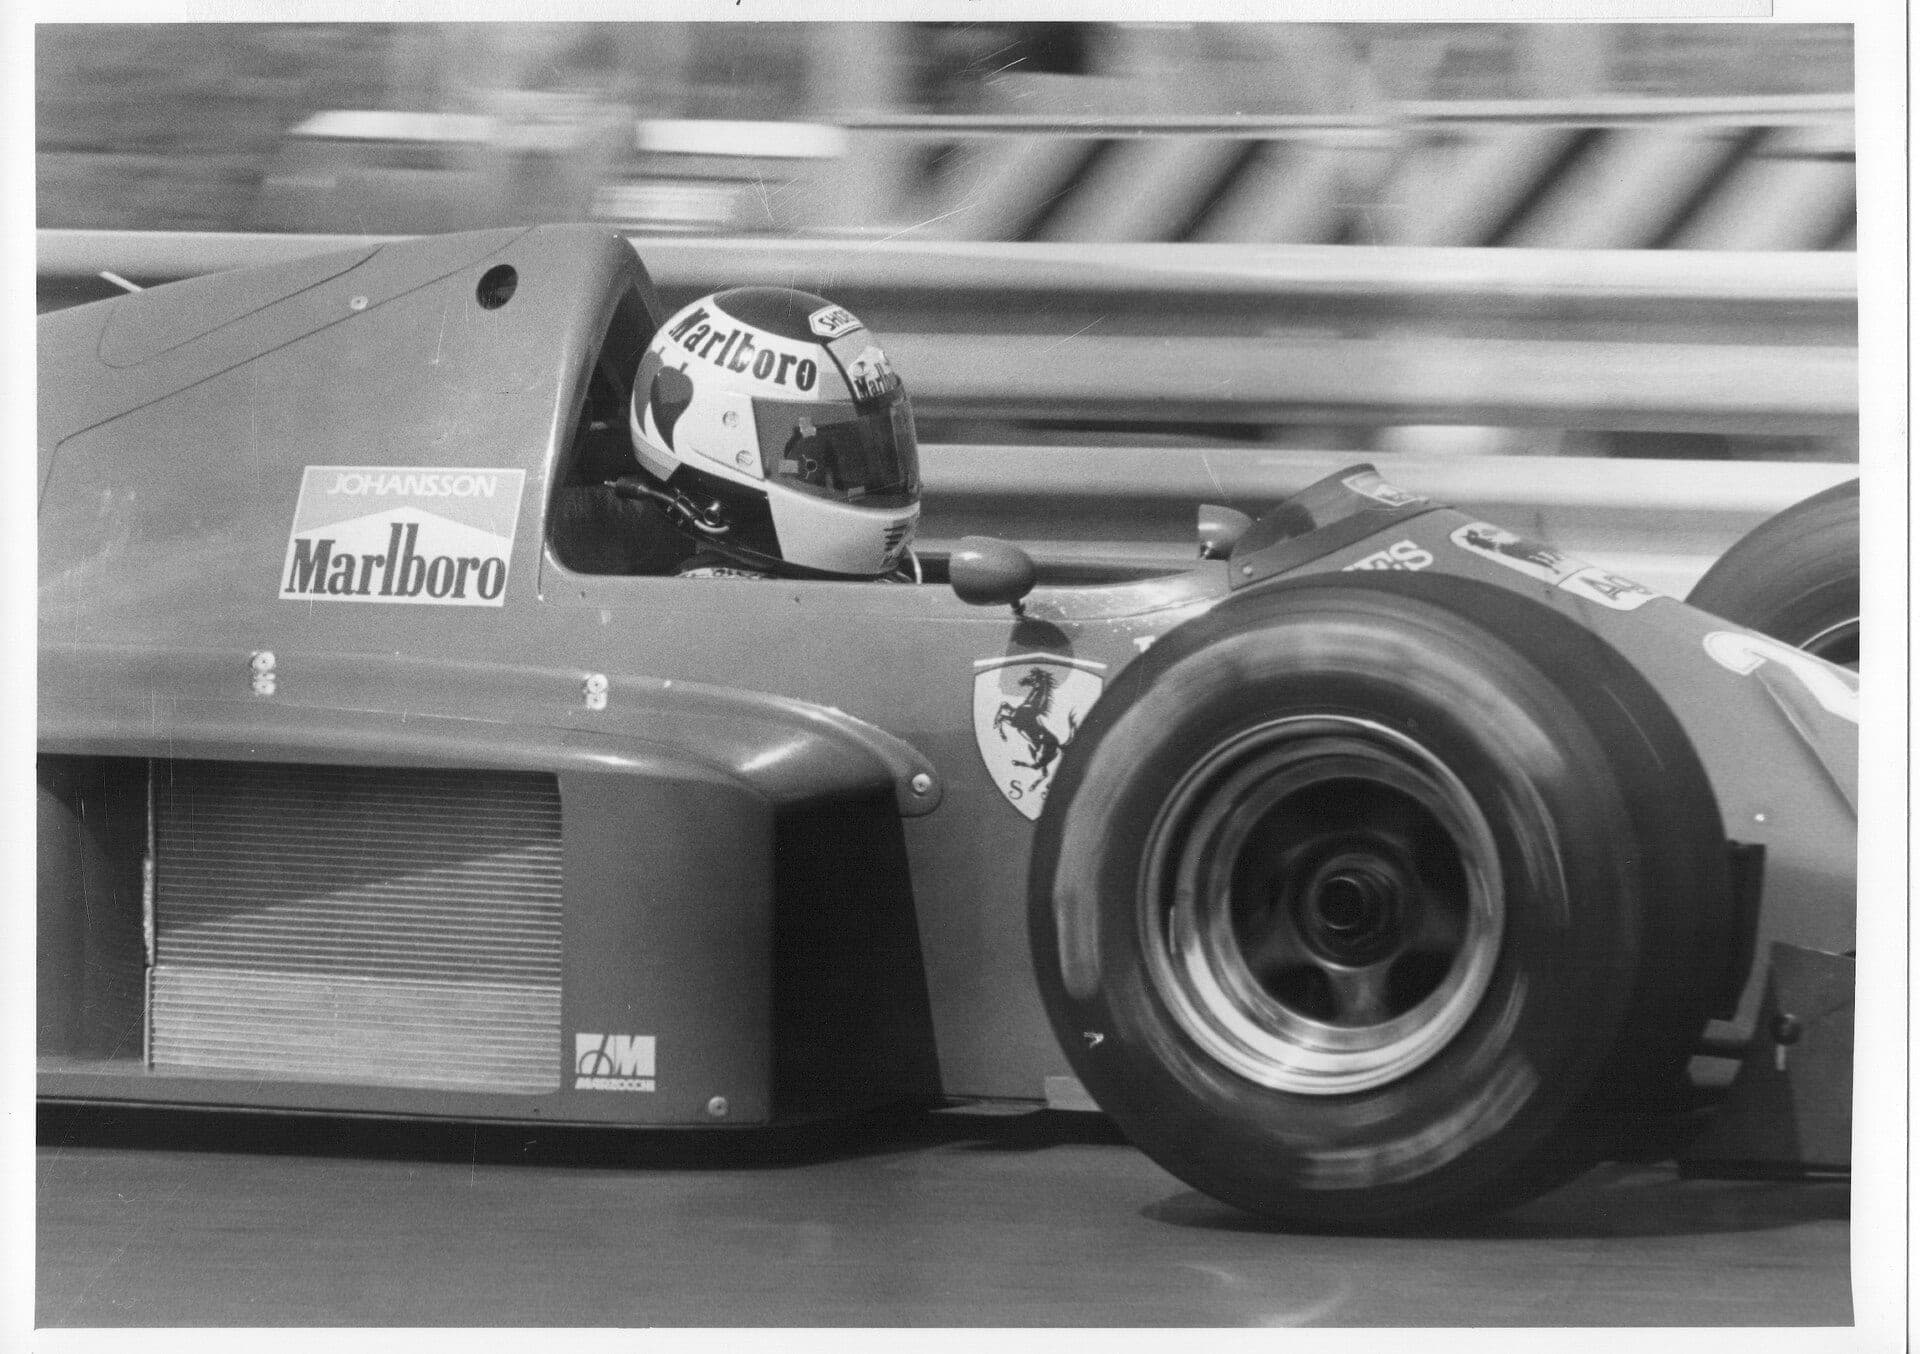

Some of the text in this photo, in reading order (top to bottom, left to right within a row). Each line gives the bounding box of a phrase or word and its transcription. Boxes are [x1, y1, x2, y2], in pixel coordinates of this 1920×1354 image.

[817, 310, 853, 331] SHO
[668, 307, 817, 392] Marlboro
[327, 474, 496, 497] JOHANSSON
[284, 522, 506, 600] Marlboro
